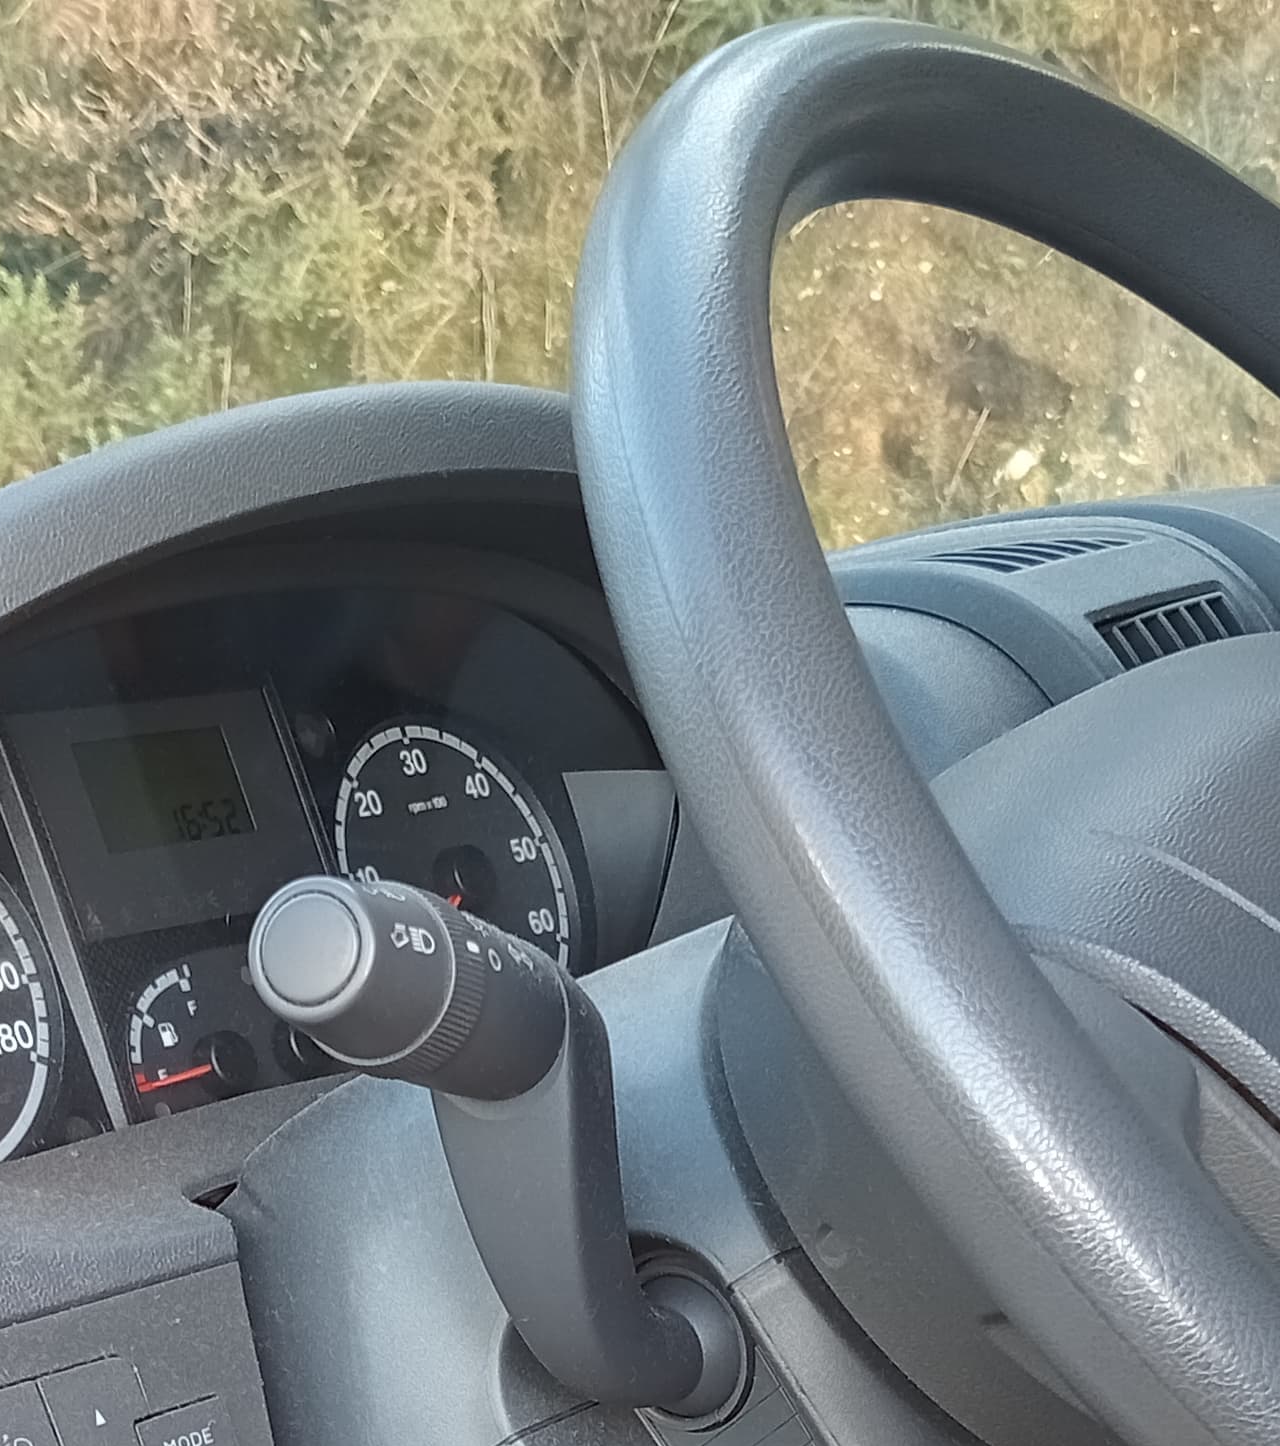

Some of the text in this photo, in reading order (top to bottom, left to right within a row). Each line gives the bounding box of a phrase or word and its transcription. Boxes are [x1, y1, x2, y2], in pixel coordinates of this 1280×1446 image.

[400, 749, 427, 776] 30
[465, 772, 490, 798] 40
[354, 790, 383, 817] 20
[509, 836, 537, 863] 50
[528, 908, 554, 935] 60
[187, 1000, 197, 1016] F
